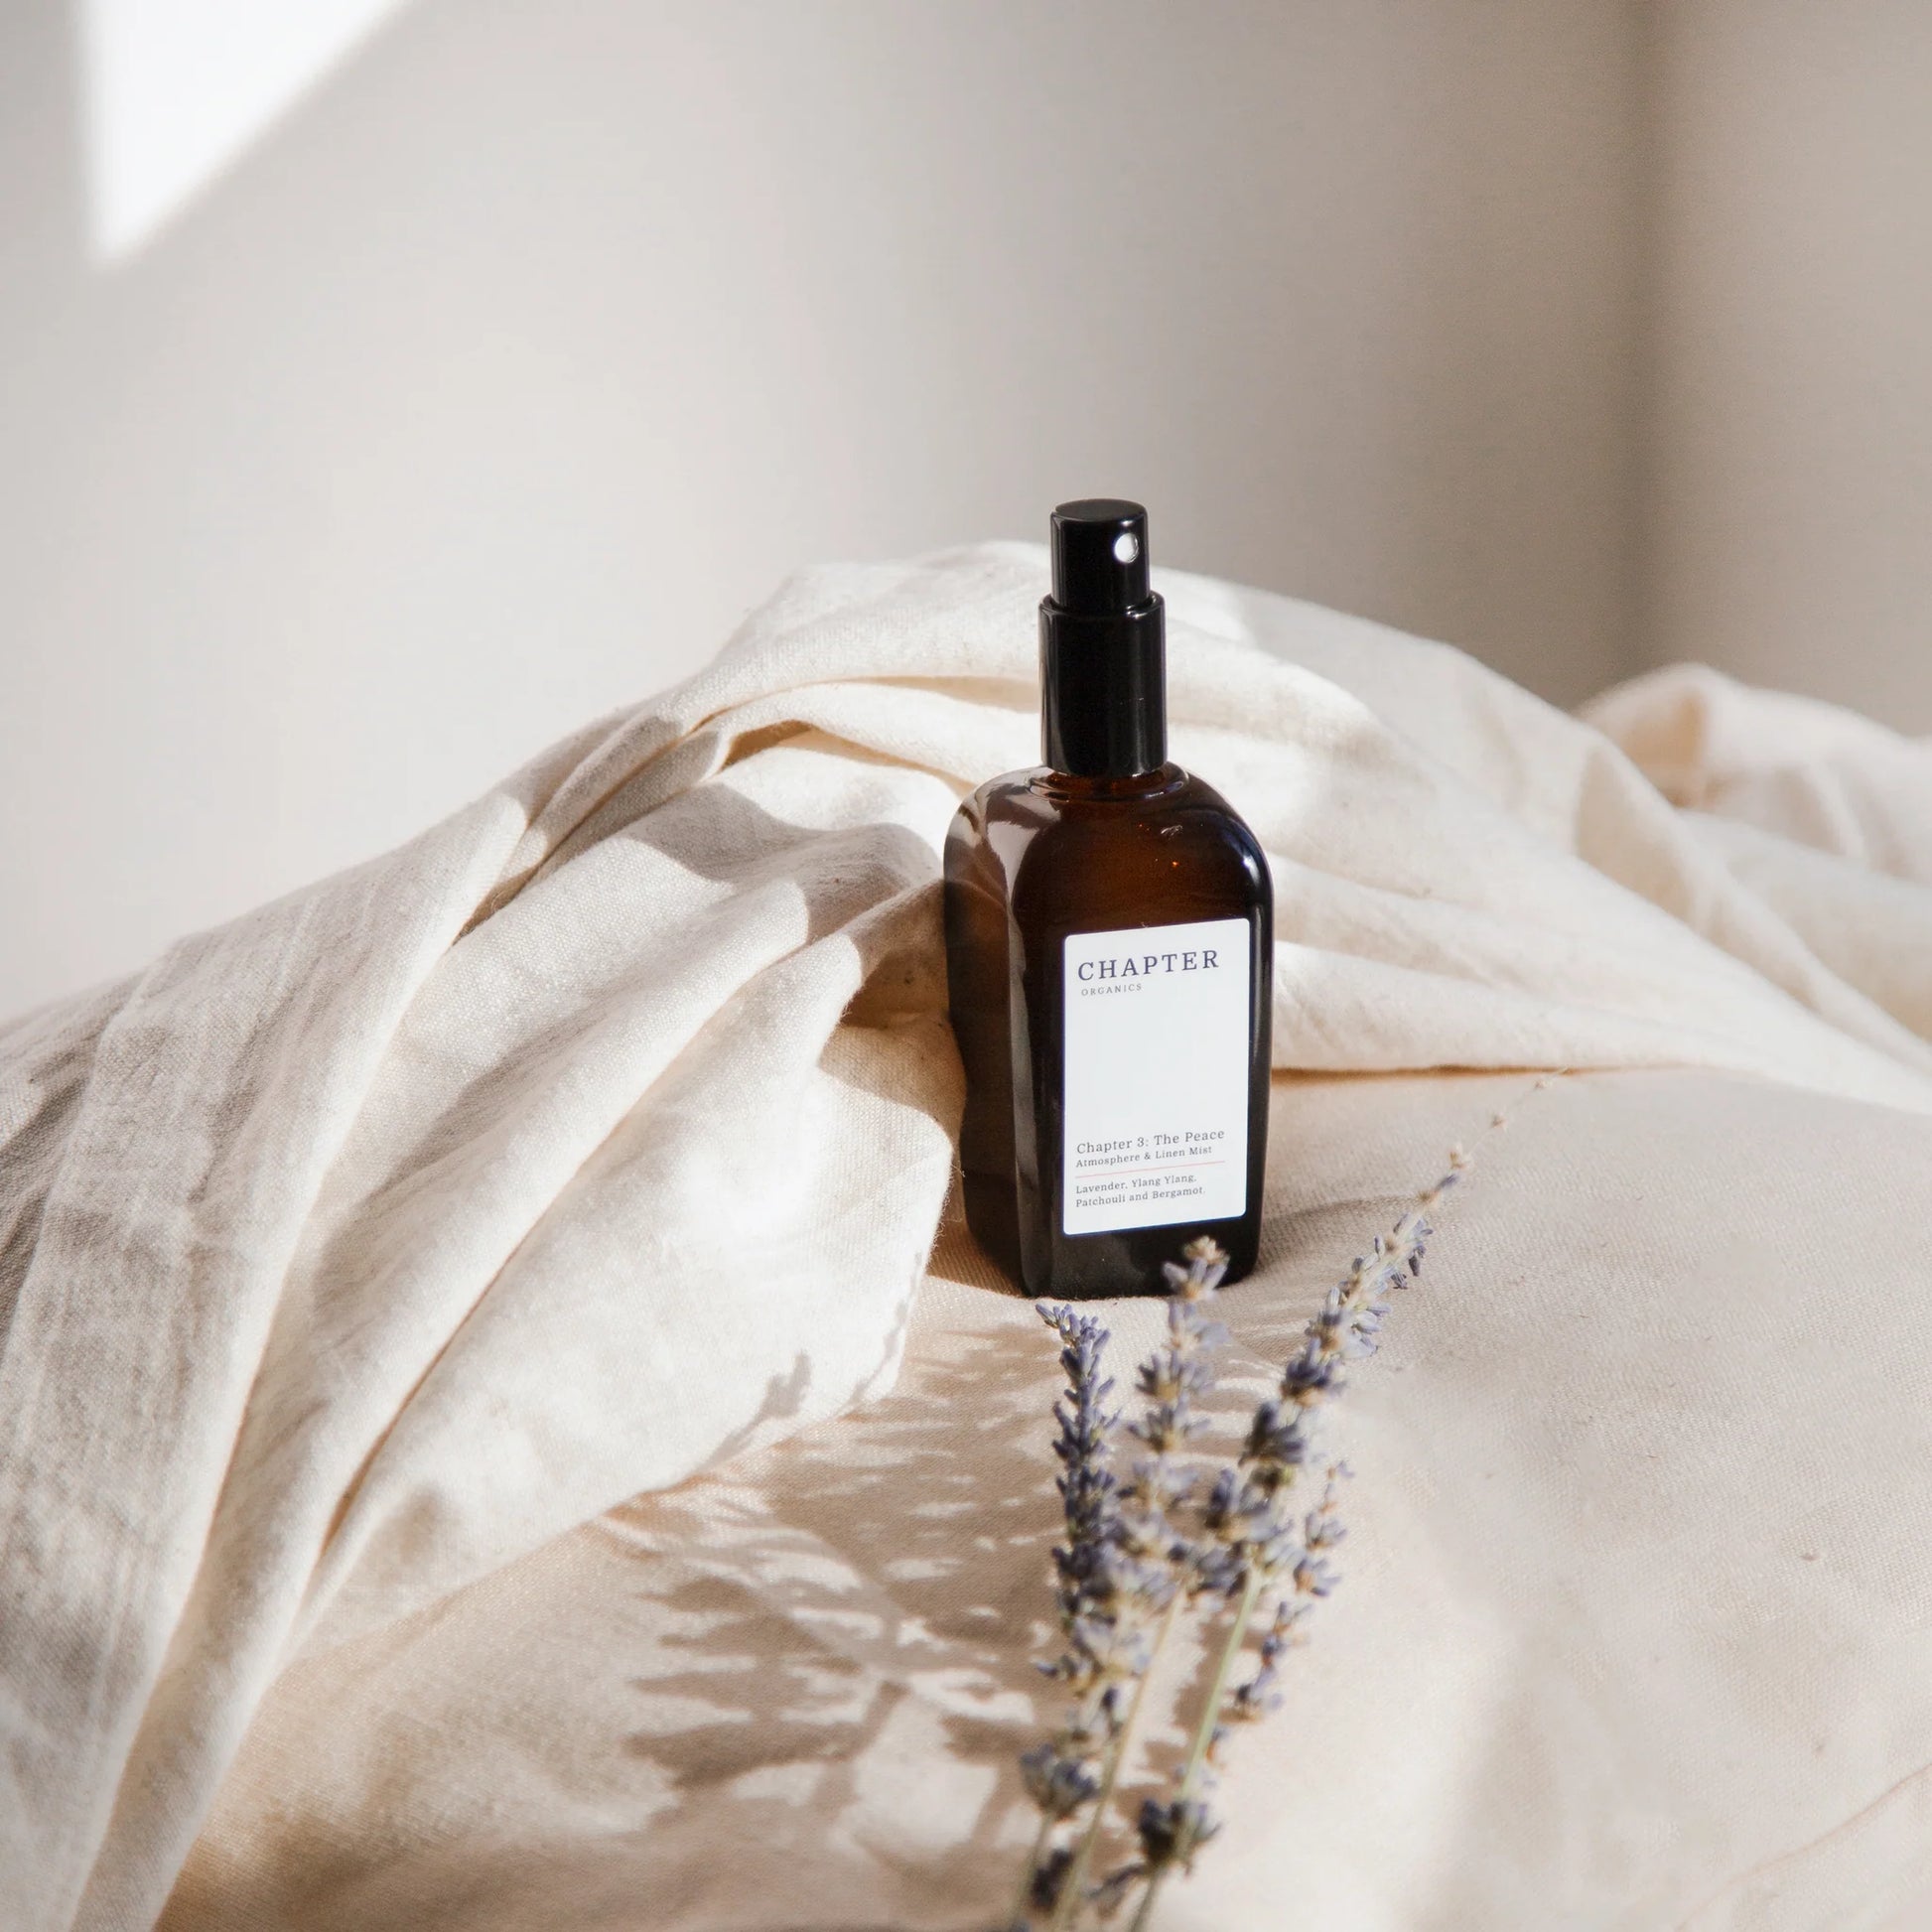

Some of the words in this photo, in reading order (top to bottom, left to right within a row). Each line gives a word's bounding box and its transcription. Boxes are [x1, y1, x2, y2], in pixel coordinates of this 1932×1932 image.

[1077, 949, 1219, 981] CHAPTER
[1081, 983, 1143, 997] ORGANICS
[1076, 1139, 1133, 1155] Chapter
[1137, 1137, 1150, 1148] 3:
[1154, 1134, 1179, 1146] The
[1184, 1130, 1225, 1143] Peace
[1075, 1154, 1141, 1168] Atmosphere
[1144, 1152, 1152, 1161] &
[1155, 1149, 1185, 1160] Linen
[1188, 1146, 1212, 1156] Mist
[1132, 1177, 1162, 1188] Ylang
[1075, 1194, 1126, 1208] Patchouli
[1129, 1190, 1149, 1202] and
